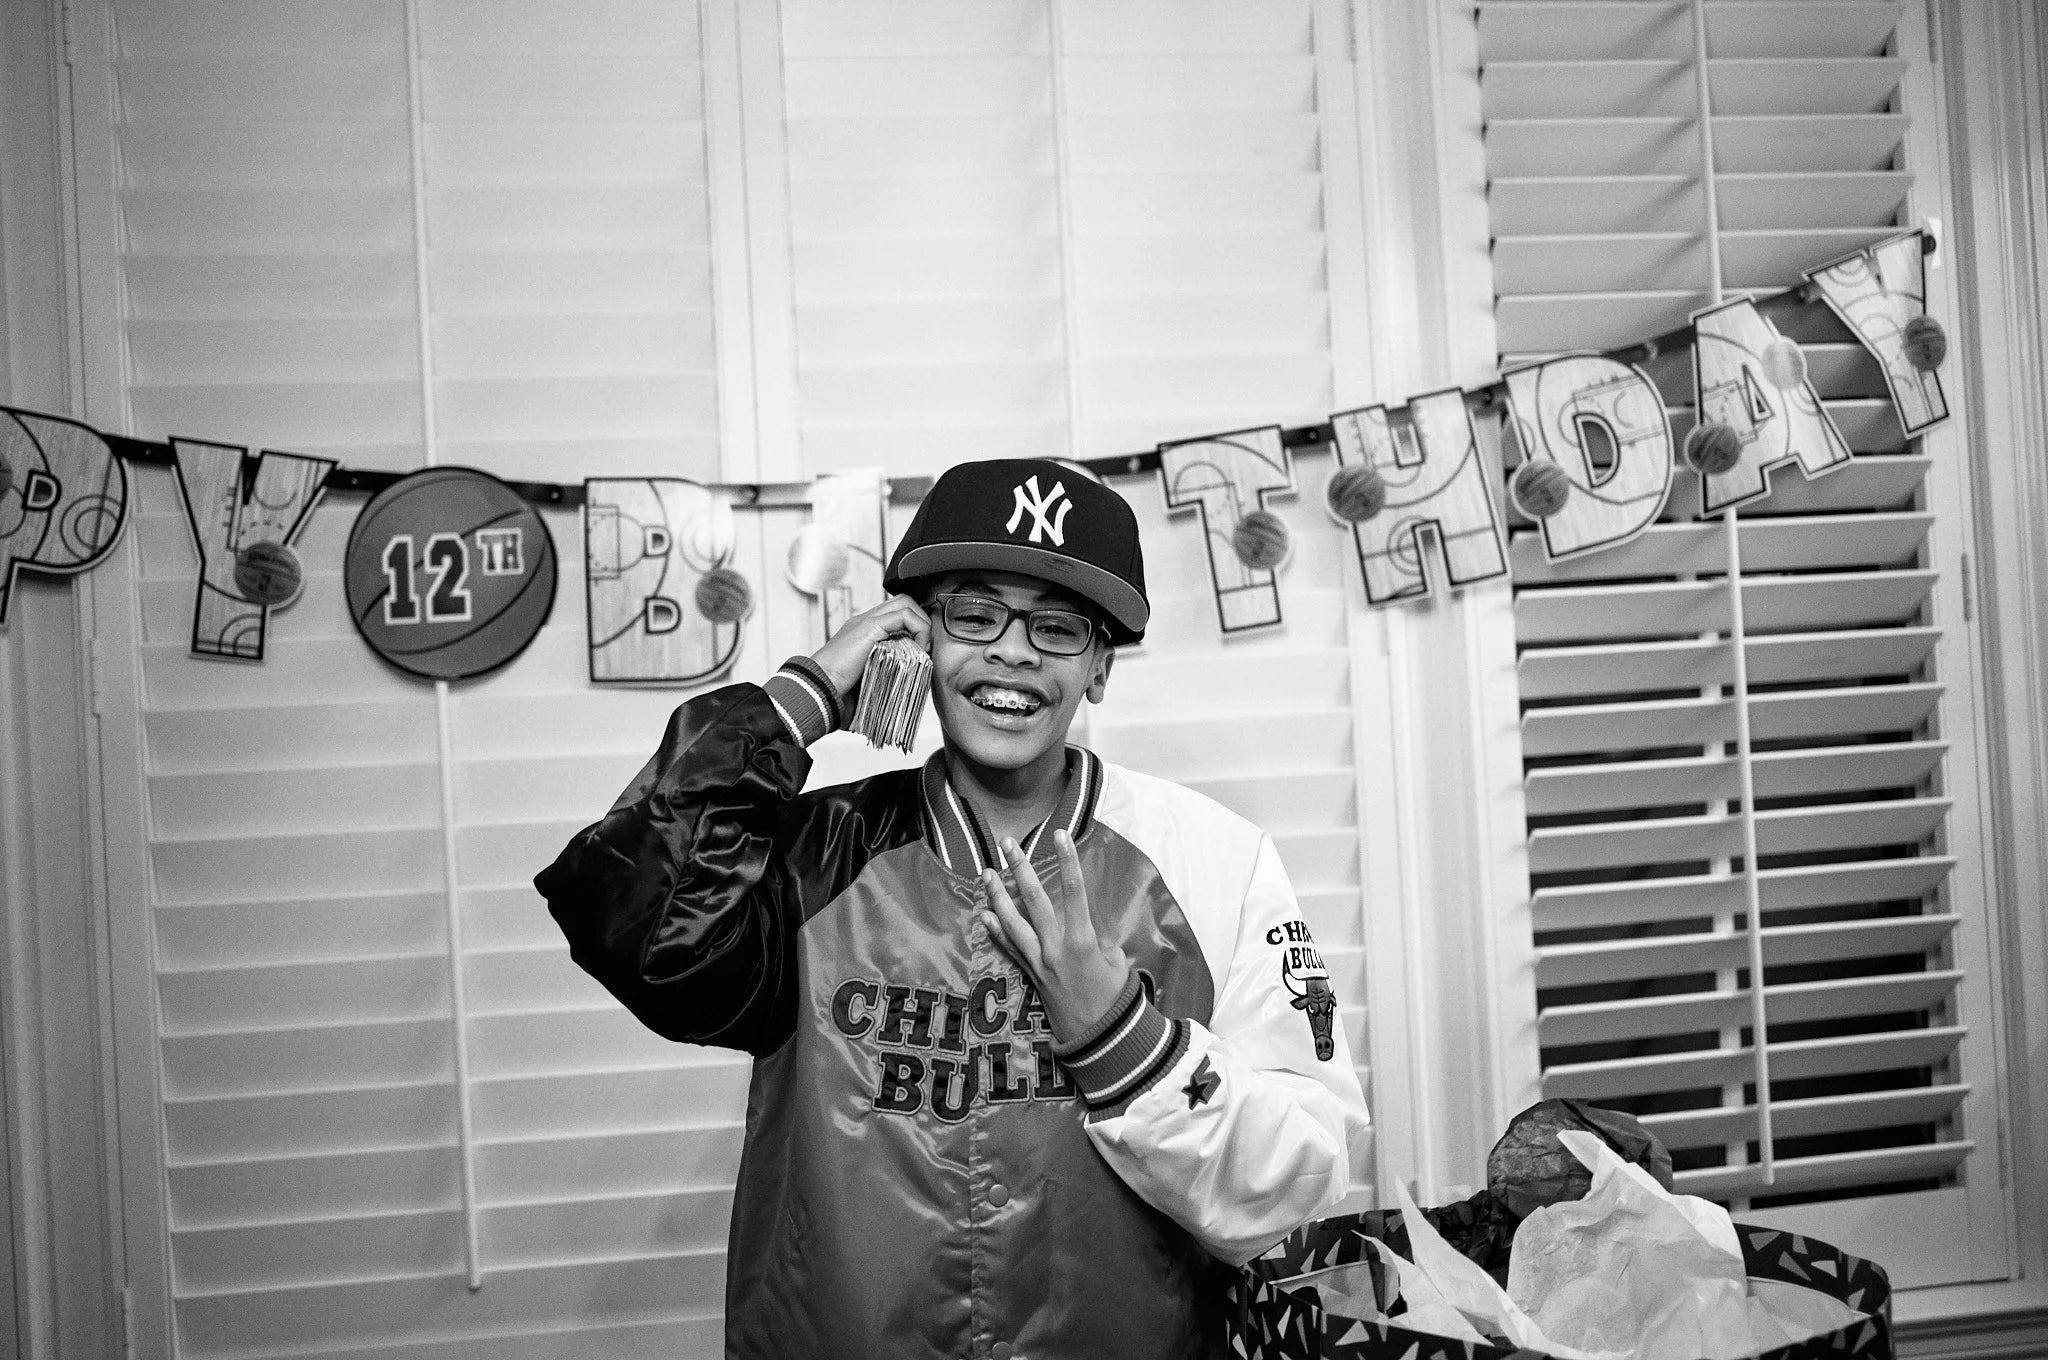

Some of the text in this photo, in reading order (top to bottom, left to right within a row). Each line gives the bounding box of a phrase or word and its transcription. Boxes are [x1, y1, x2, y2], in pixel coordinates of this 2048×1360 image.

[584, 229, 1950, 686] BITHDAY
[1005, 474, 1073, 547] NY
[830, 973, 1055, 1056] CHICA
[871, 1040, 1080, 1124] BULL
